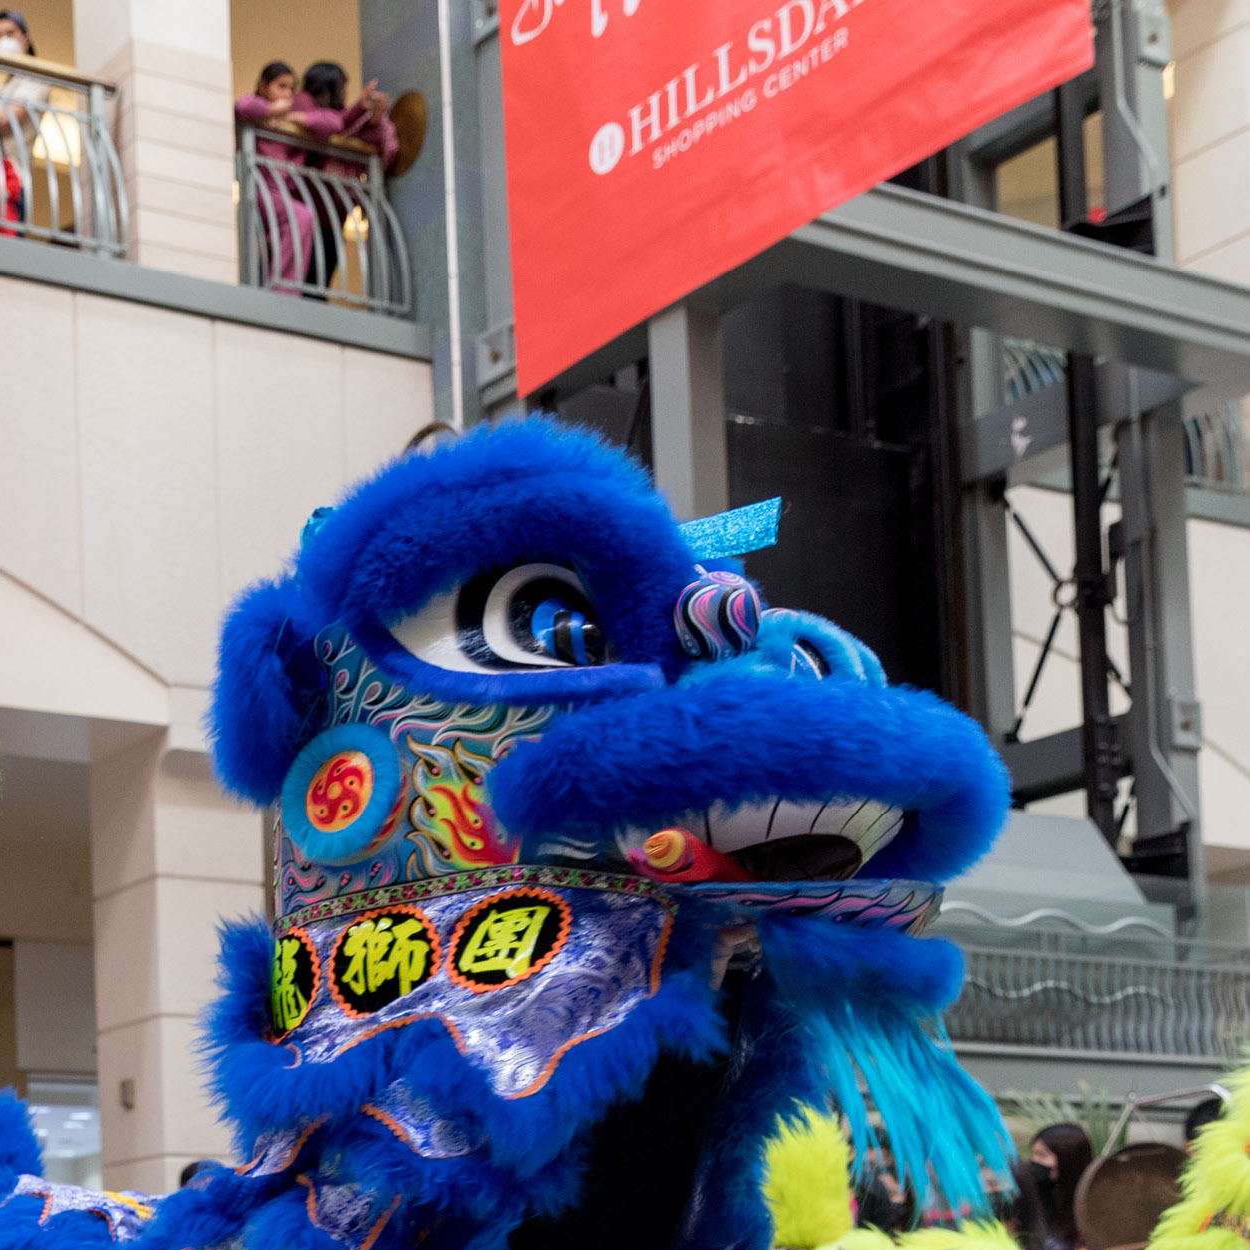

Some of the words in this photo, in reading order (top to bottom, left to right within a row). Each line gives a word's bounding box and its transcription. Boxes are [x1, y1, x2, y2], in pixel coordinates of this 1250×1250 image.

[628, 0, 866, 157] HILLSDA
[652, 88, 758, 169] SHOPPING
[763, 26, 849, 98] CENTER
